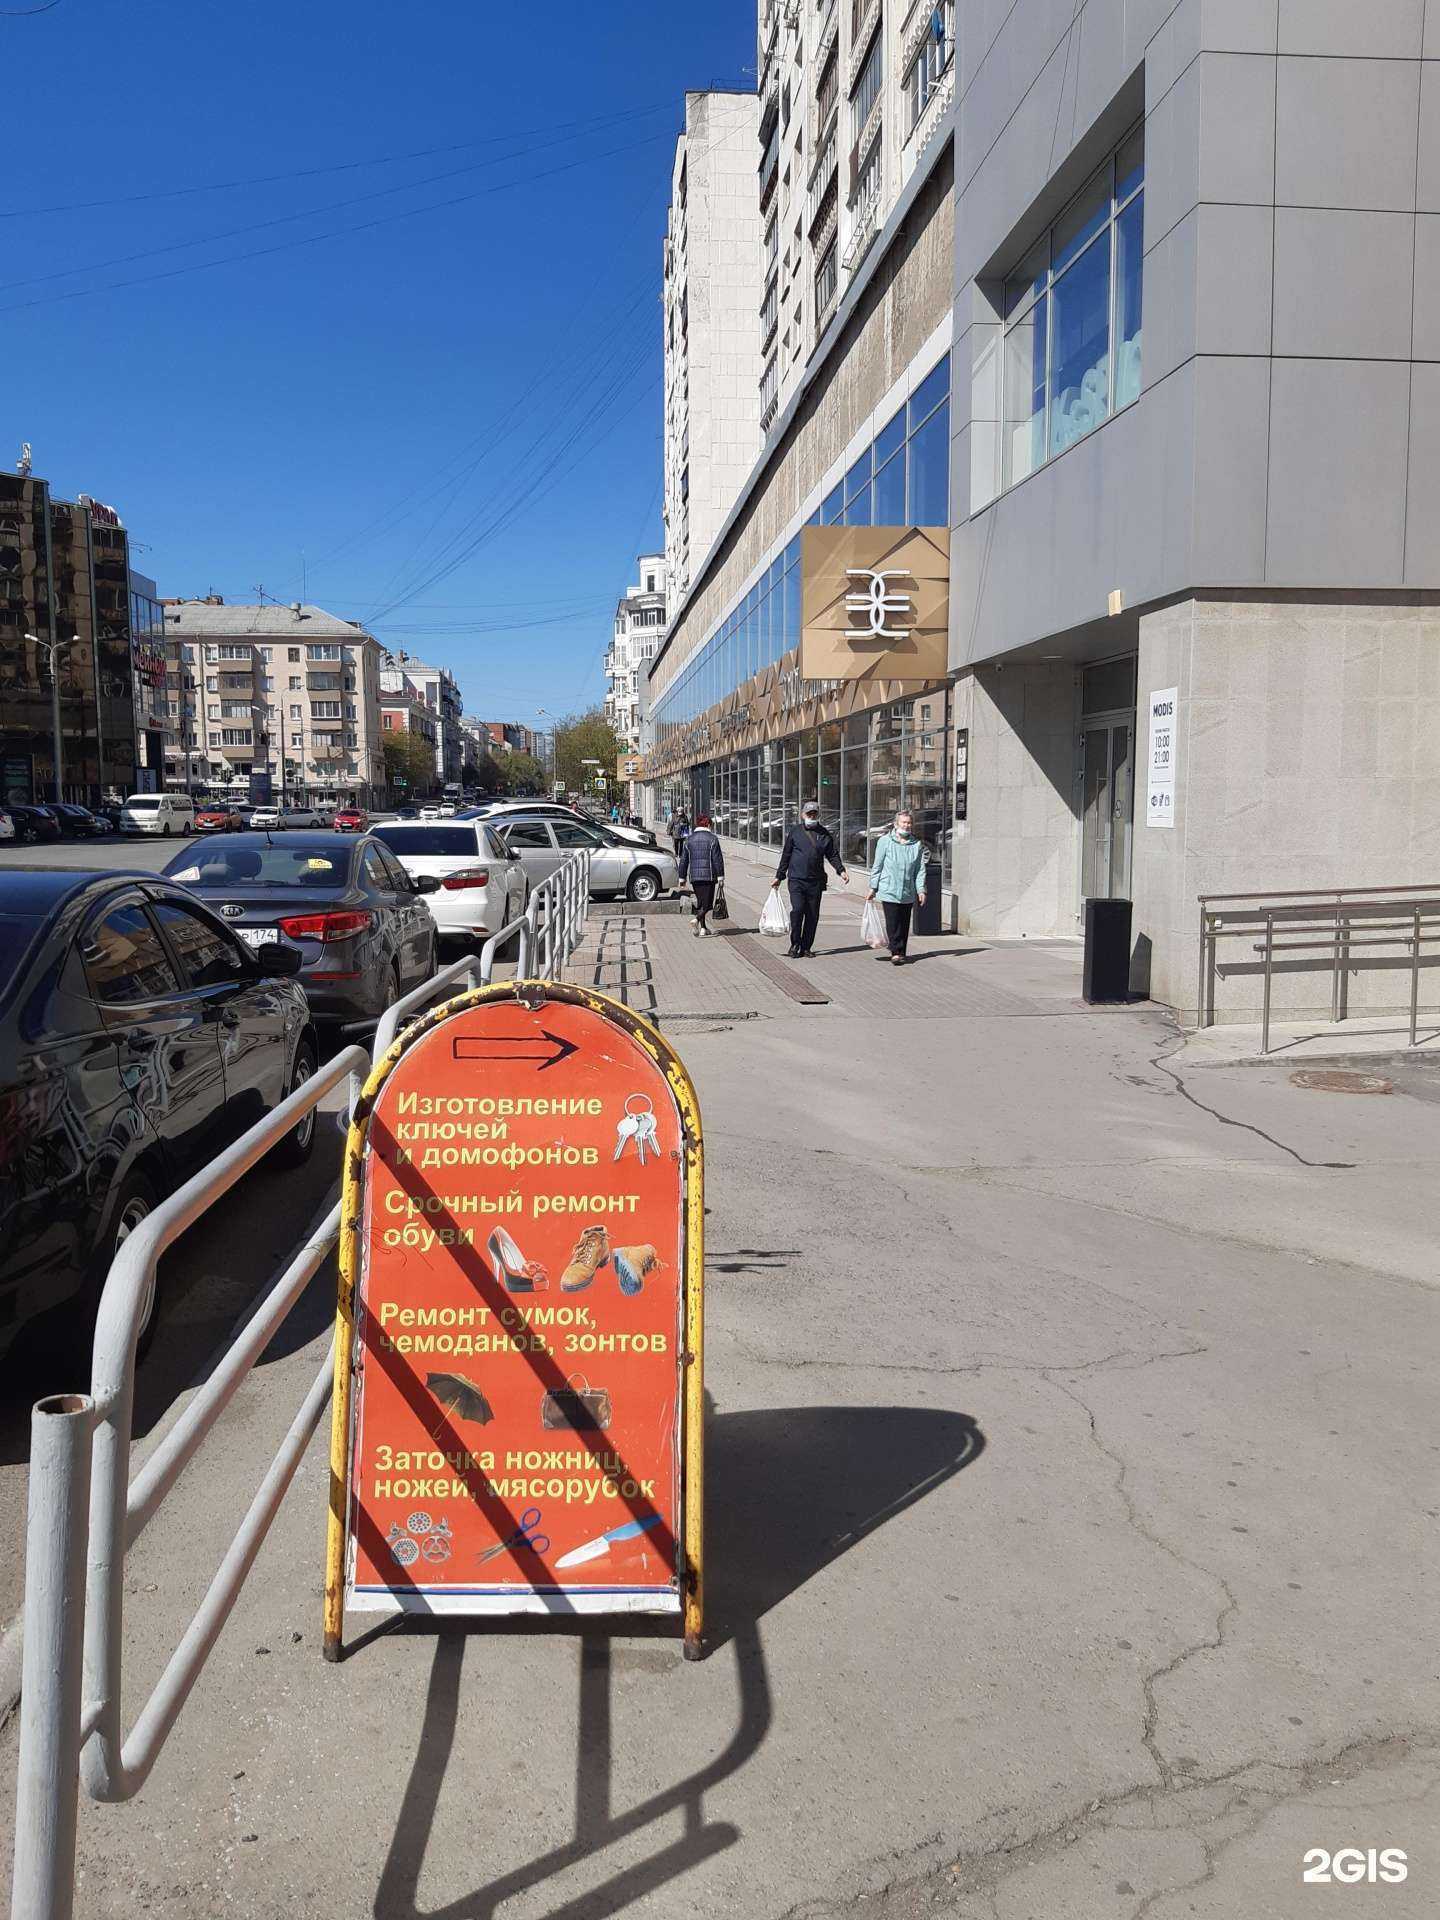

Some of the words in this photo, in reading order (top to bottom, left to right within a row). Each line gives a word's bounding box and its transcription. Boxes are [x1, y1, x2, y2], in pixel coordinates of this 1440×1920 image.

[1153, 702, 1173, 717] MODIS
[1155, 735, 1170, 748] 10:00
[1154, 751, 1170, 763] 21:00
[253, 929, 276, 940] 174
[397, 1092, 602, 1115] Изготовление
[397, 1118, 507, 1139] ключей
[396, 1147, 411, 1165] и
[421, 1142, 598, 1169] домофонов
[385, 1189, 523, 1218] Срочный
[533, 1193, 640, 1218] ремонт
[383, 1222, 474, 1250] обуви
[380, 1302, 490, 1327] Ремонт
[501, 1306, 597, 1331] сумок,
[379, 1333, 554, 1356] чемоданов,
[565, 1333, 667, 1353] зонтов
[375, 1446, 495, 1471] Заточка
[506, 1450, 628, 1475] ножниц,
[489, 1476, 656, 1504] мясорубок
